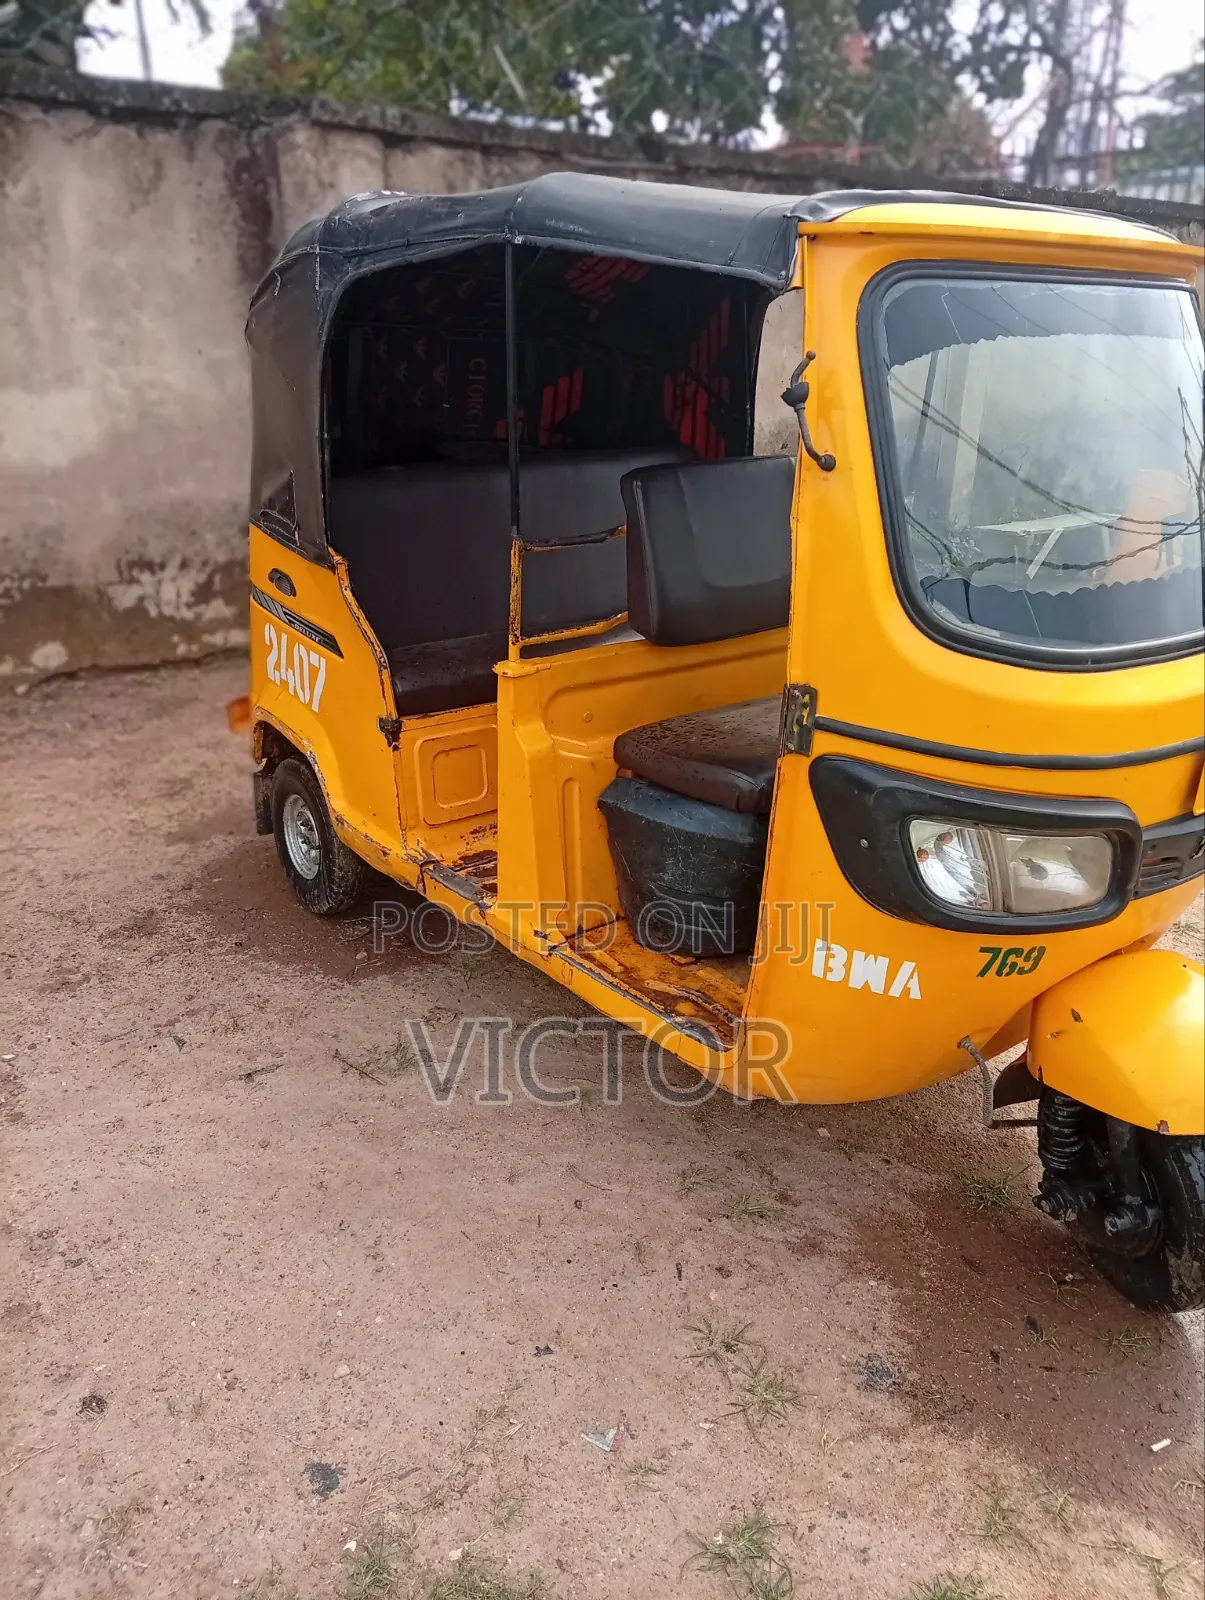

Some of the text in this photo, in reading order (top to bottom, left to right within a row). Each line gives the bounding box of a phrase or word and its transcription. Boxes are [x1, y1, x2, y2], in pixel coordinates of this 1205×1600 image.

[294, 623, 321, 643] DELUXE
[264, 622, 327, 713] 2407
[811, 938, 922, 1000] BWA
[976, 945, 1047, 978] 769
